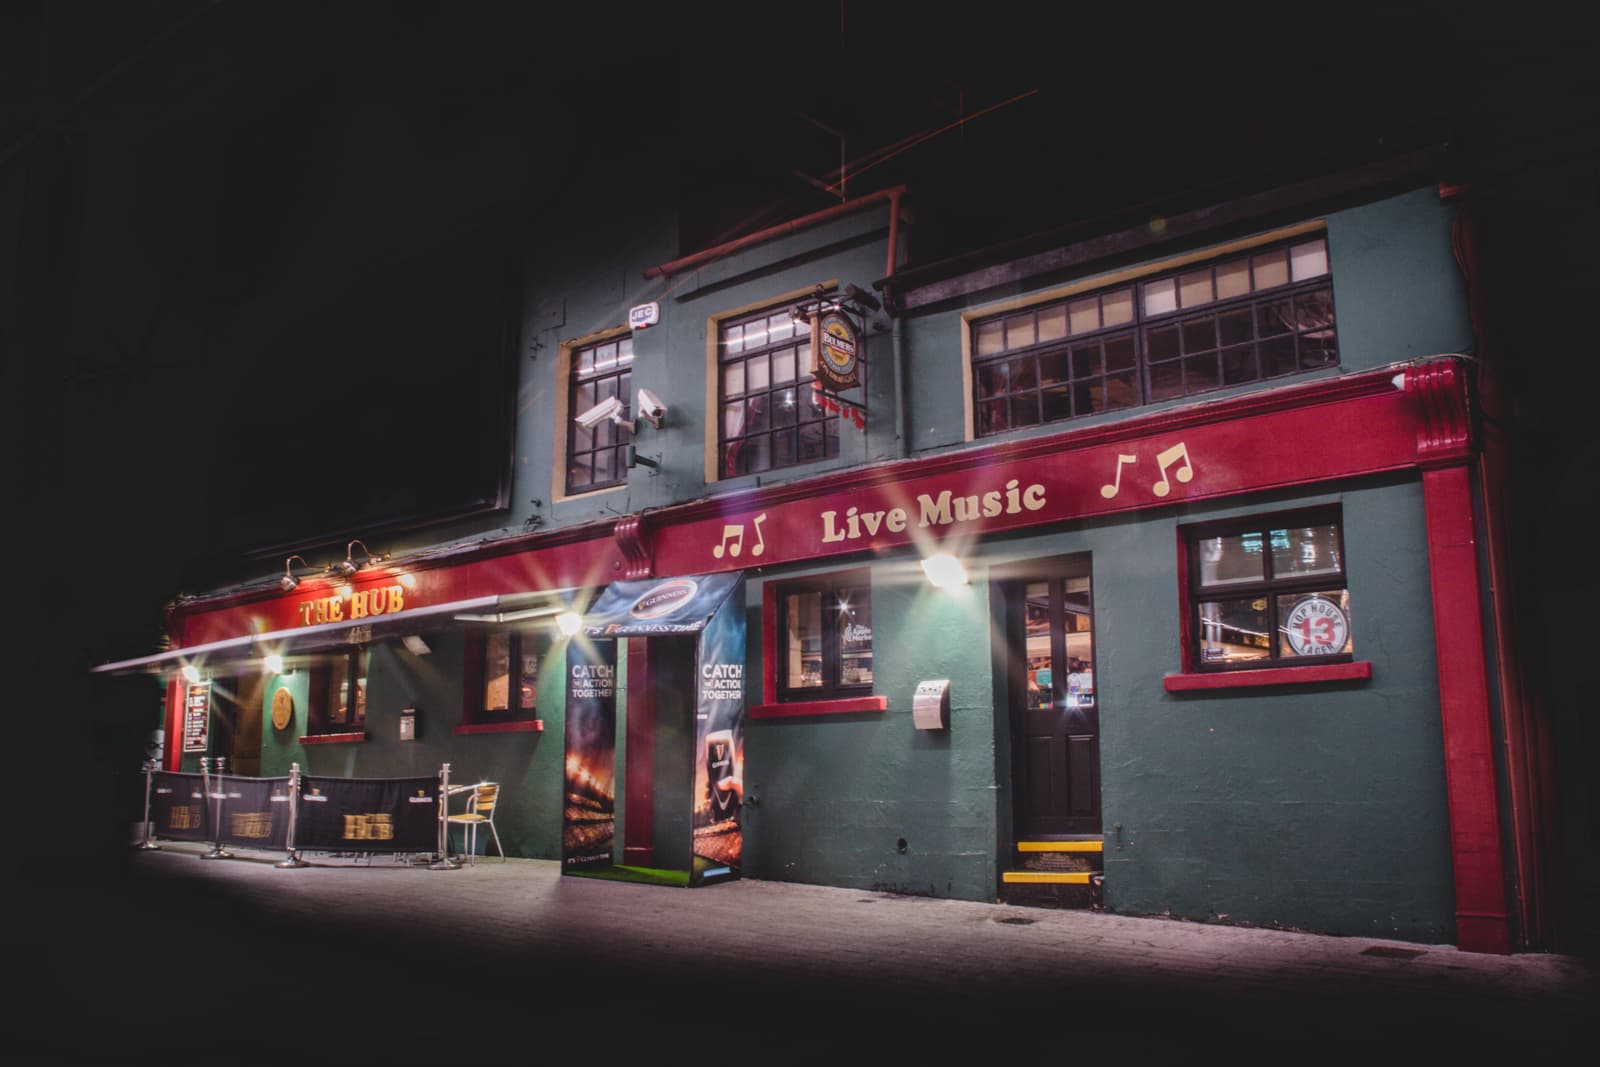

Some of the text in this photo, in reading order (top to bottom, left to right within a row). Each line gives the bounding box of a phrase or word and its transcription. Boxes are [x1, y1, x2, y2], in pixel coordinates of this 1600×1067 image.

[821, 479, 1046, 543] Live Music
[299, 585, 404, 625] THE HUB
[646, 589, 688, 606] GUINNESS
[1292, 604, 1341, 629] HOP HOUSE
[1297, 617, 1336, 645] 13
[1300, 642, 1335, 655] LAGER
[572, 664, 614, 678] CATCH
[702, 664, 743, 679] CATCH
[703, 690, 742, 700] TOGETHER
